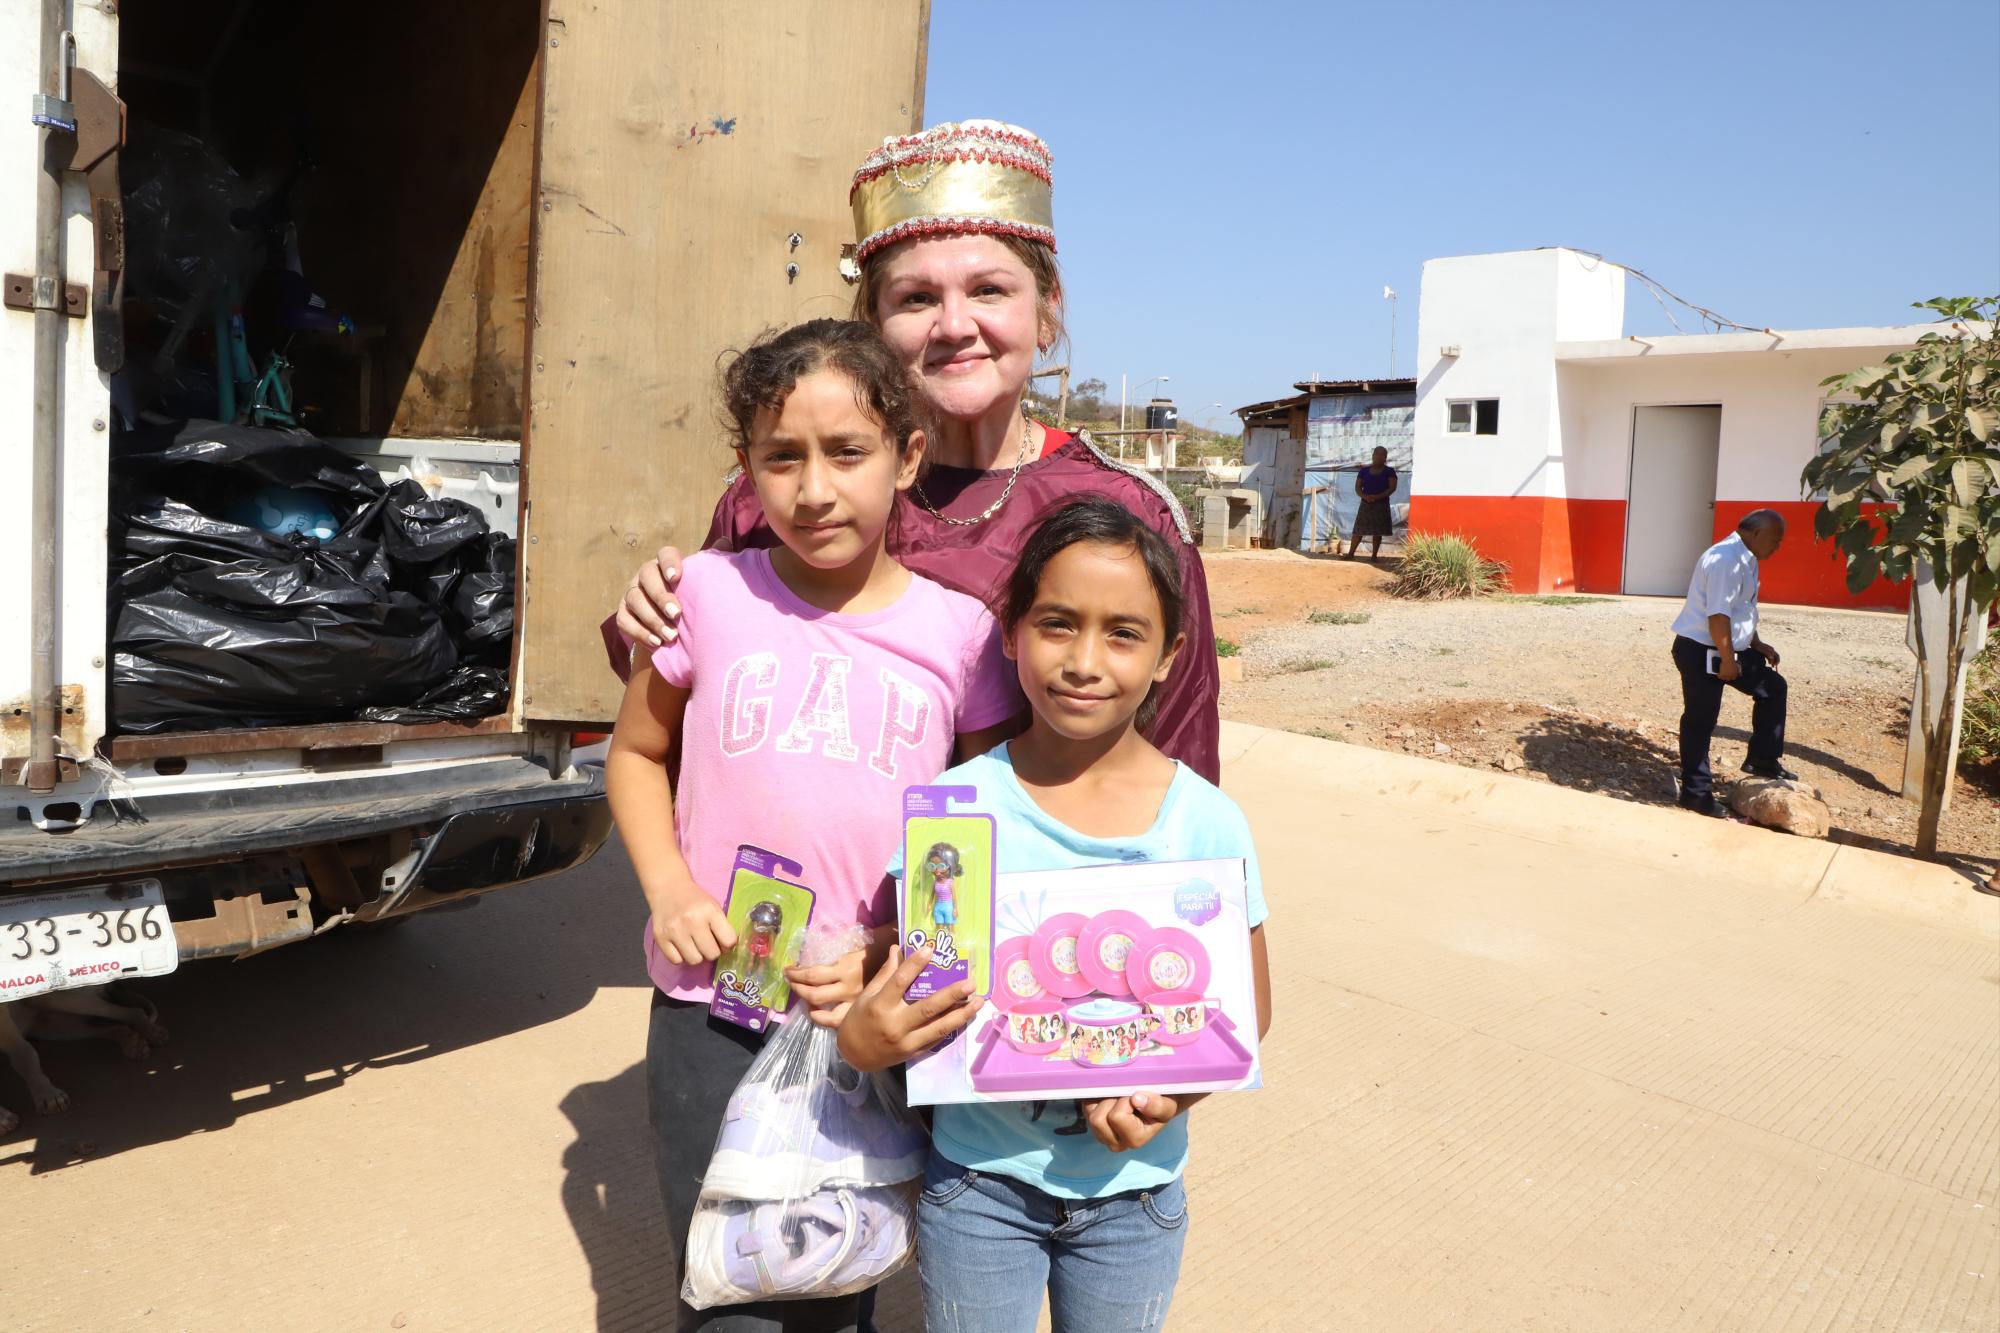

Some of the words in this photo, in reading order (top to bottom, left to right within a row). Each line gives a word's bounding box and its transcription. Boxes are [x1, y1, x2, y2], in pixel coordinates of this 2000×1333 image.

[720, 651, 931, 780] GAP
[1181, 902, 1203, 912] PARA
[6, 904, 162, 961] 33-366
[955, 963, 966, 971] 4+
[720, 970, 762, 1007] Polly
